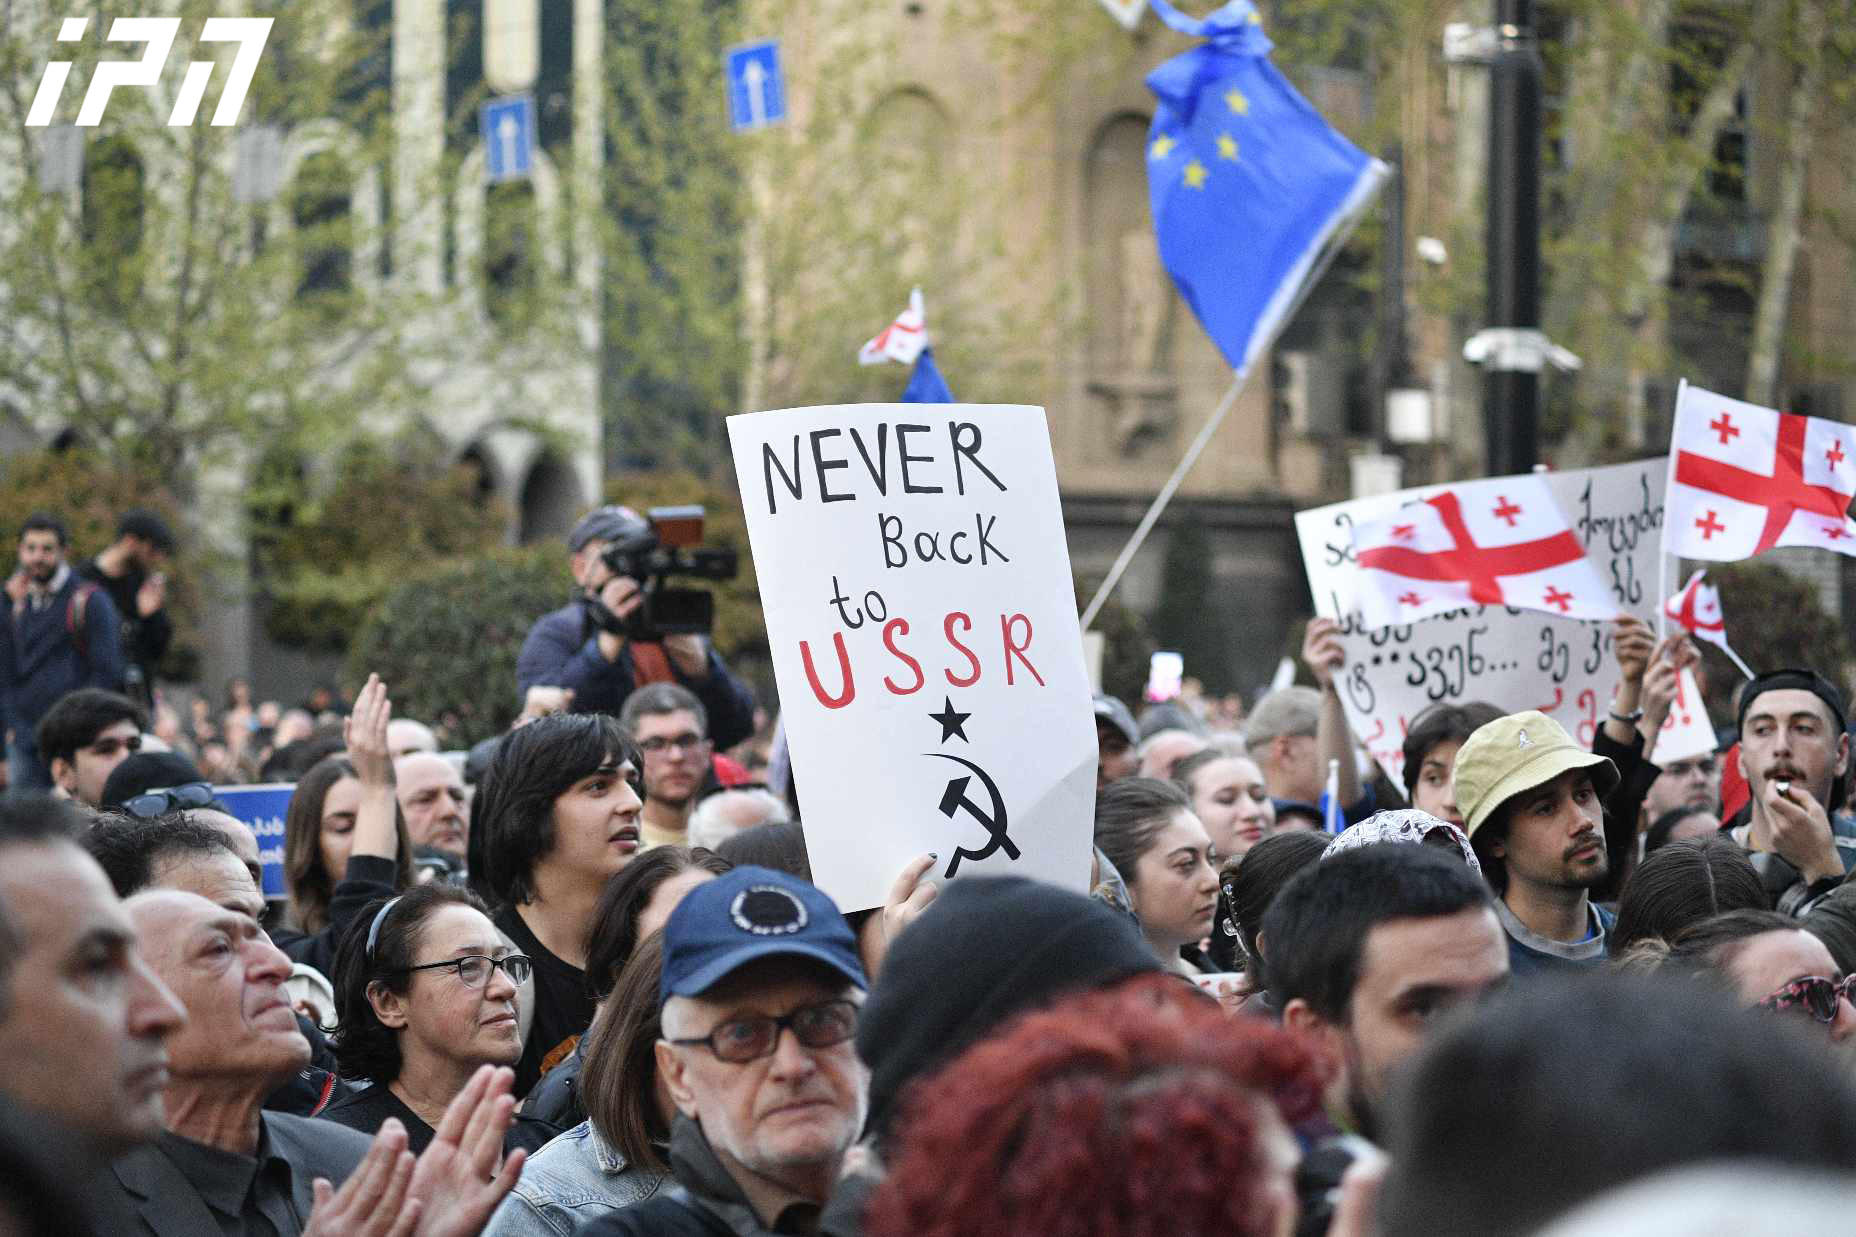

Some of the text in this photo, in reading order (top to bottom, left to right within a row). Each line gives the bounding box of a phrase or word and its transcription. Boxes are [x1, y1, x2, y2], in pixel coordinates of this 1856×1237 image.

[762, 421, 1008, 515] NEVER
[829, 575, 888, 630] to
[798, 610, 1047, 710] USSR
